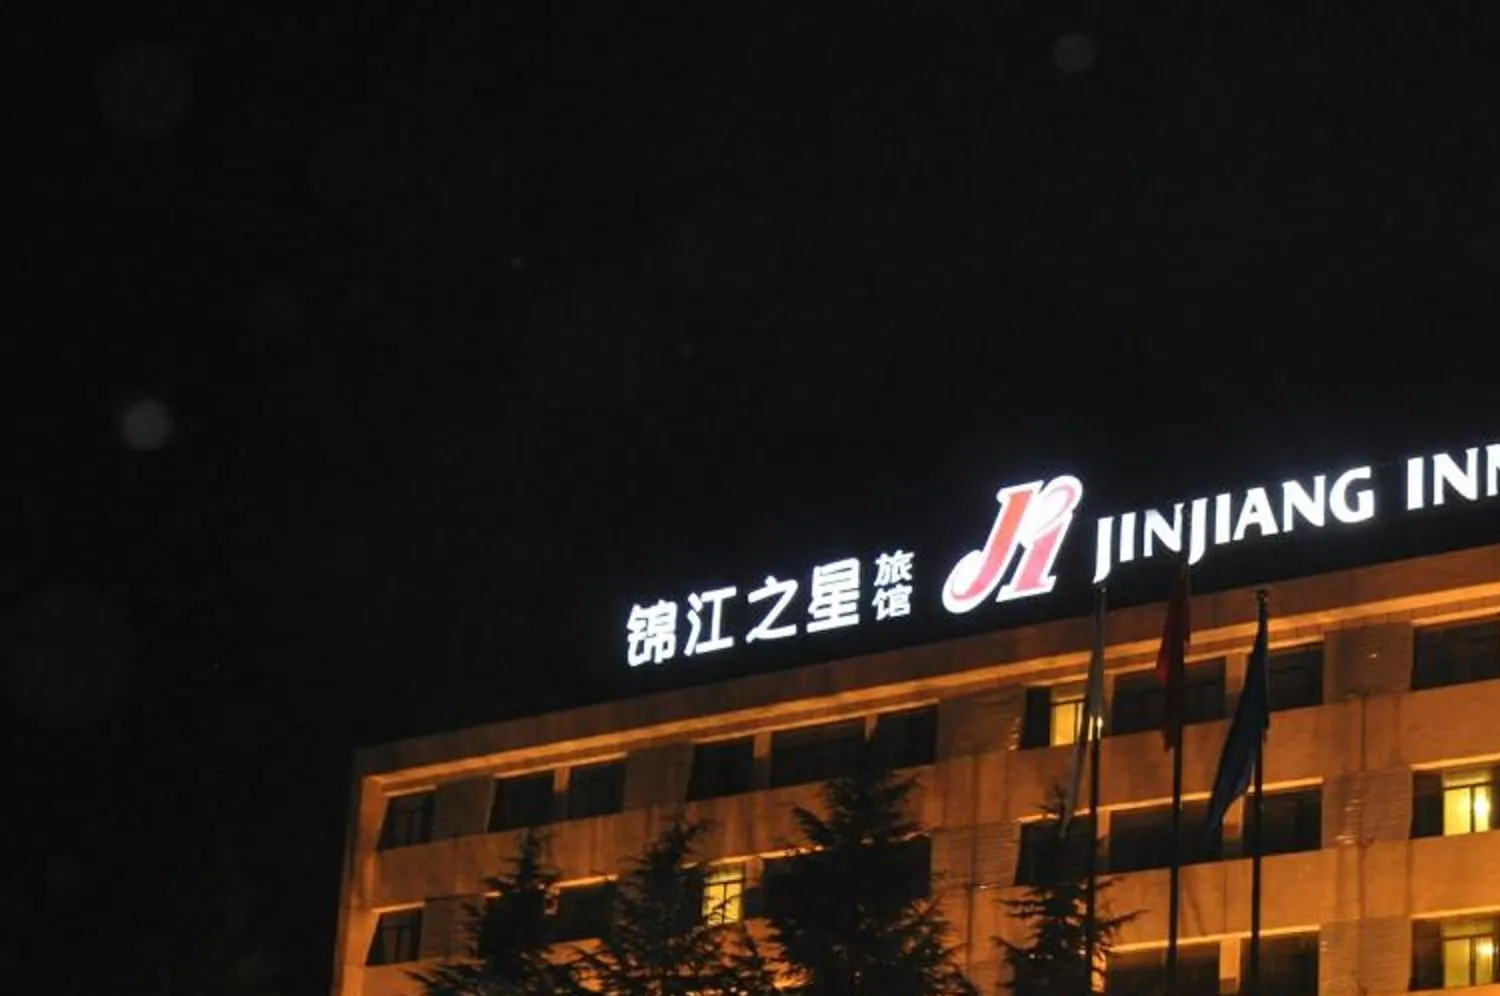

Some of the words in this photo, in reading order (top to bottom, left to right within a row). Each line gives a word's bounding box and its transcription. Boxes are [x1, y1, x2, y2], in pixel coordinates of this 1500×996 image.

[1093, 465, 1375, 584] JINJIANG
[626, 557, 861, 667] 锦江之星
[872, 549, 915, 621] 旅馆
